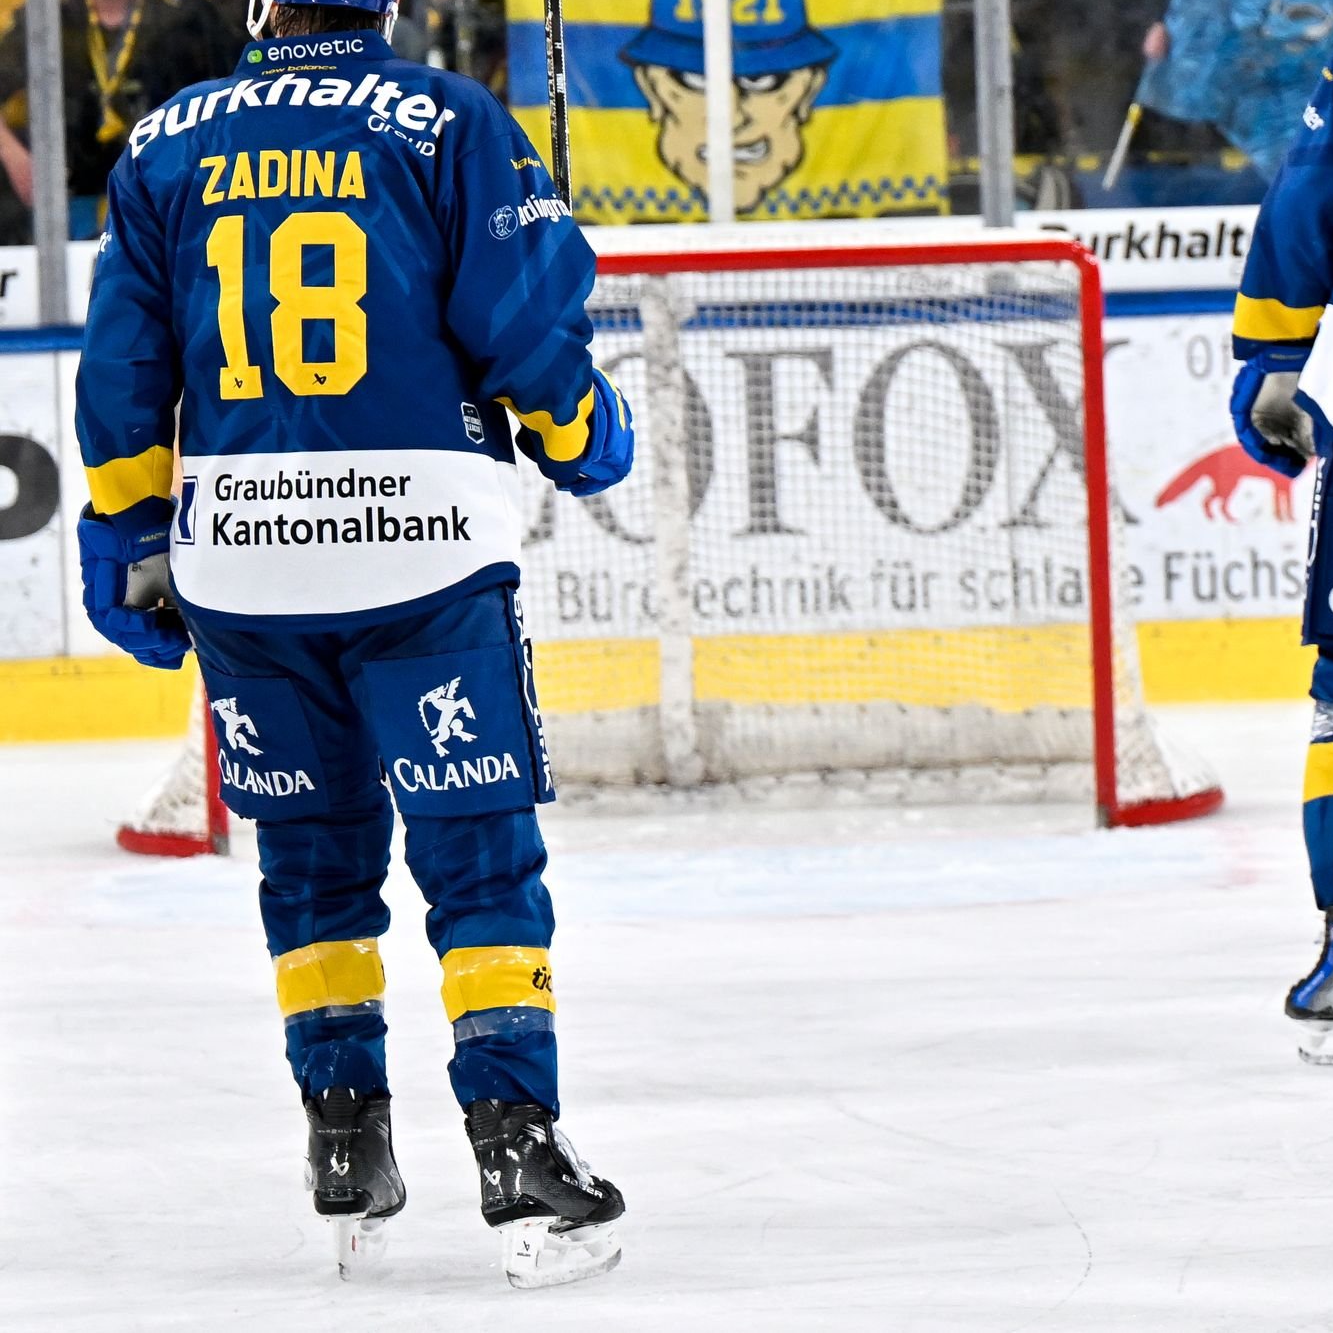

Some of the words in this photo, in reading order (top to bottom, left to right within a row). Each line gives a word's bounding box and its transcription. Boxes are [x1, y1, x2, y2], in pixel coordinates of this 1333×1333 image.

[267, 37, 364, 62] enovetic
[128, 72, 457, 160] Burkhalter
[199, 149, 368, 207] ZADINA
[1042, 222, 1246, 263] urkhalt
[206, 211, 368, 400] 18
[214, 468, 412, 502] Graubündner
[212, 507, 471, 547] Kantonalbank
[558, 569, 852, 623] Bürechnik
[871, 563, 933, 612] für
[959, 556, 1145, 611] schlae
[1164, 549, 1303, 602] Füchs
[219, 752, 315, 797] CALANDA
[394, 753, 520, 792] CALANDA
